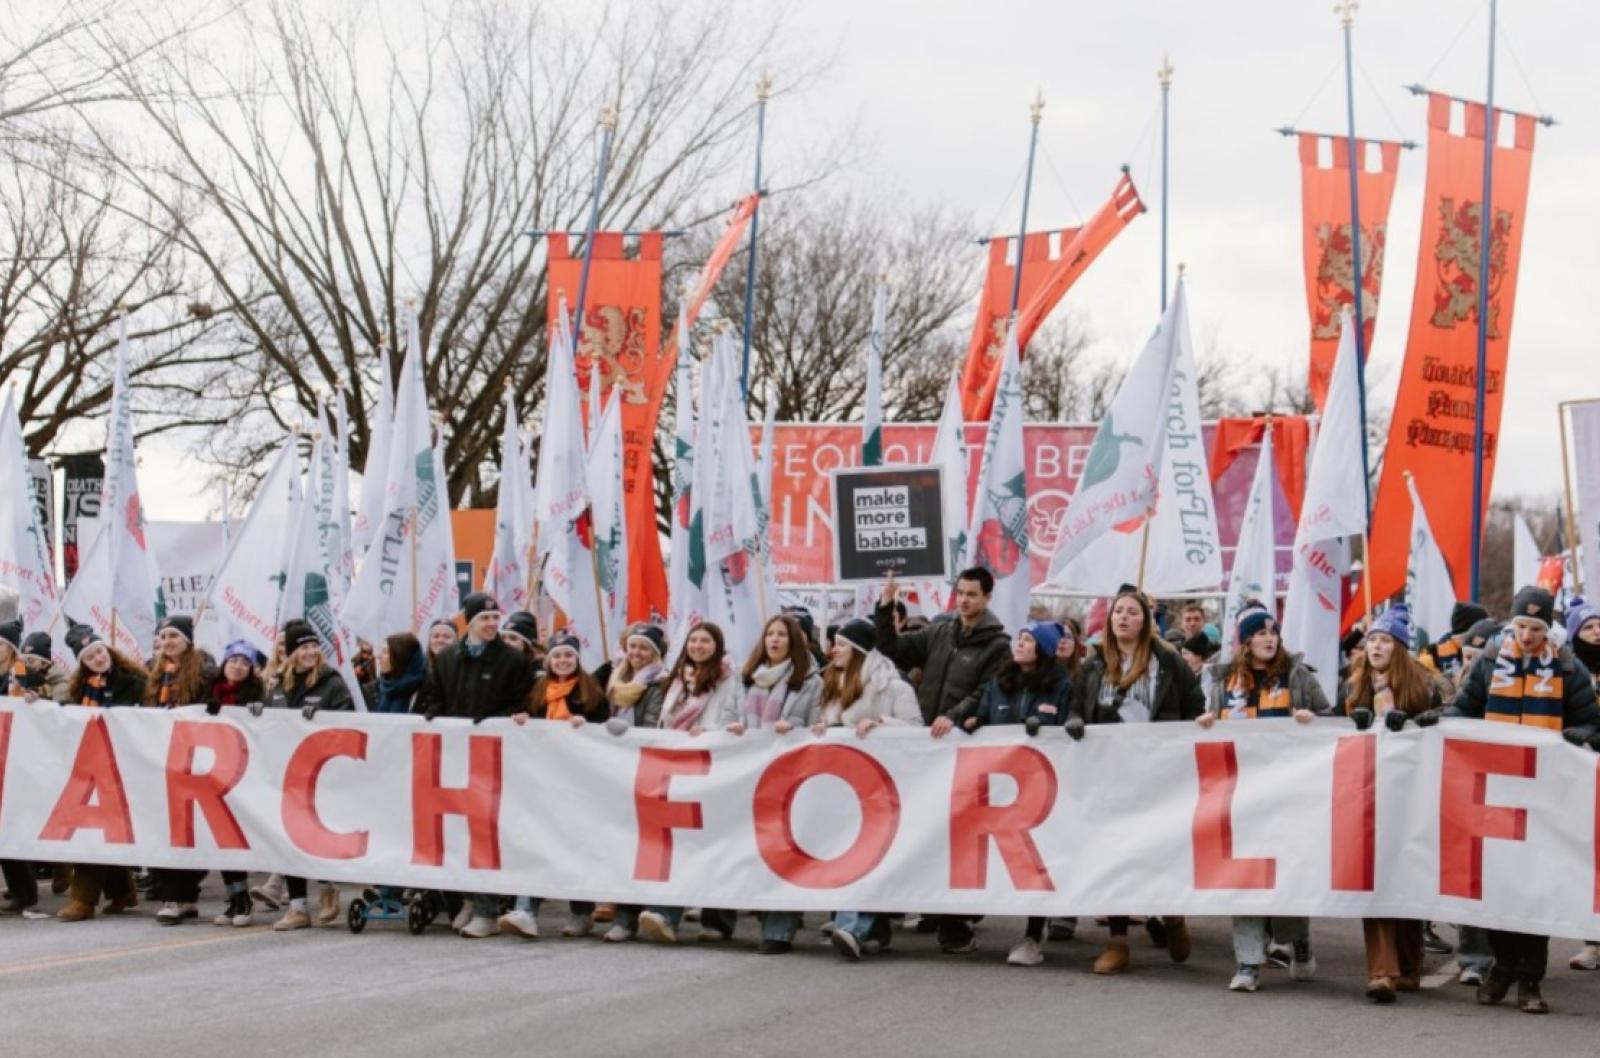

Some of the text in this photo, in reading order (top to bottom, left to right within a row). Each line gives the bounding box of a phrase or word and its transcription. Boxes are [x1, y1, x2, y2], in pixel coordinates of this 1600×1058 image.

[856, 489, 905, 506] make
[857, 511, 905, 525] more
[858, 531, 925, 549] babies.
[161, 575, 204, 593] HE
[633, 744, 1058, 893] FOR
[1192, 734, 1600, 915] LIF
